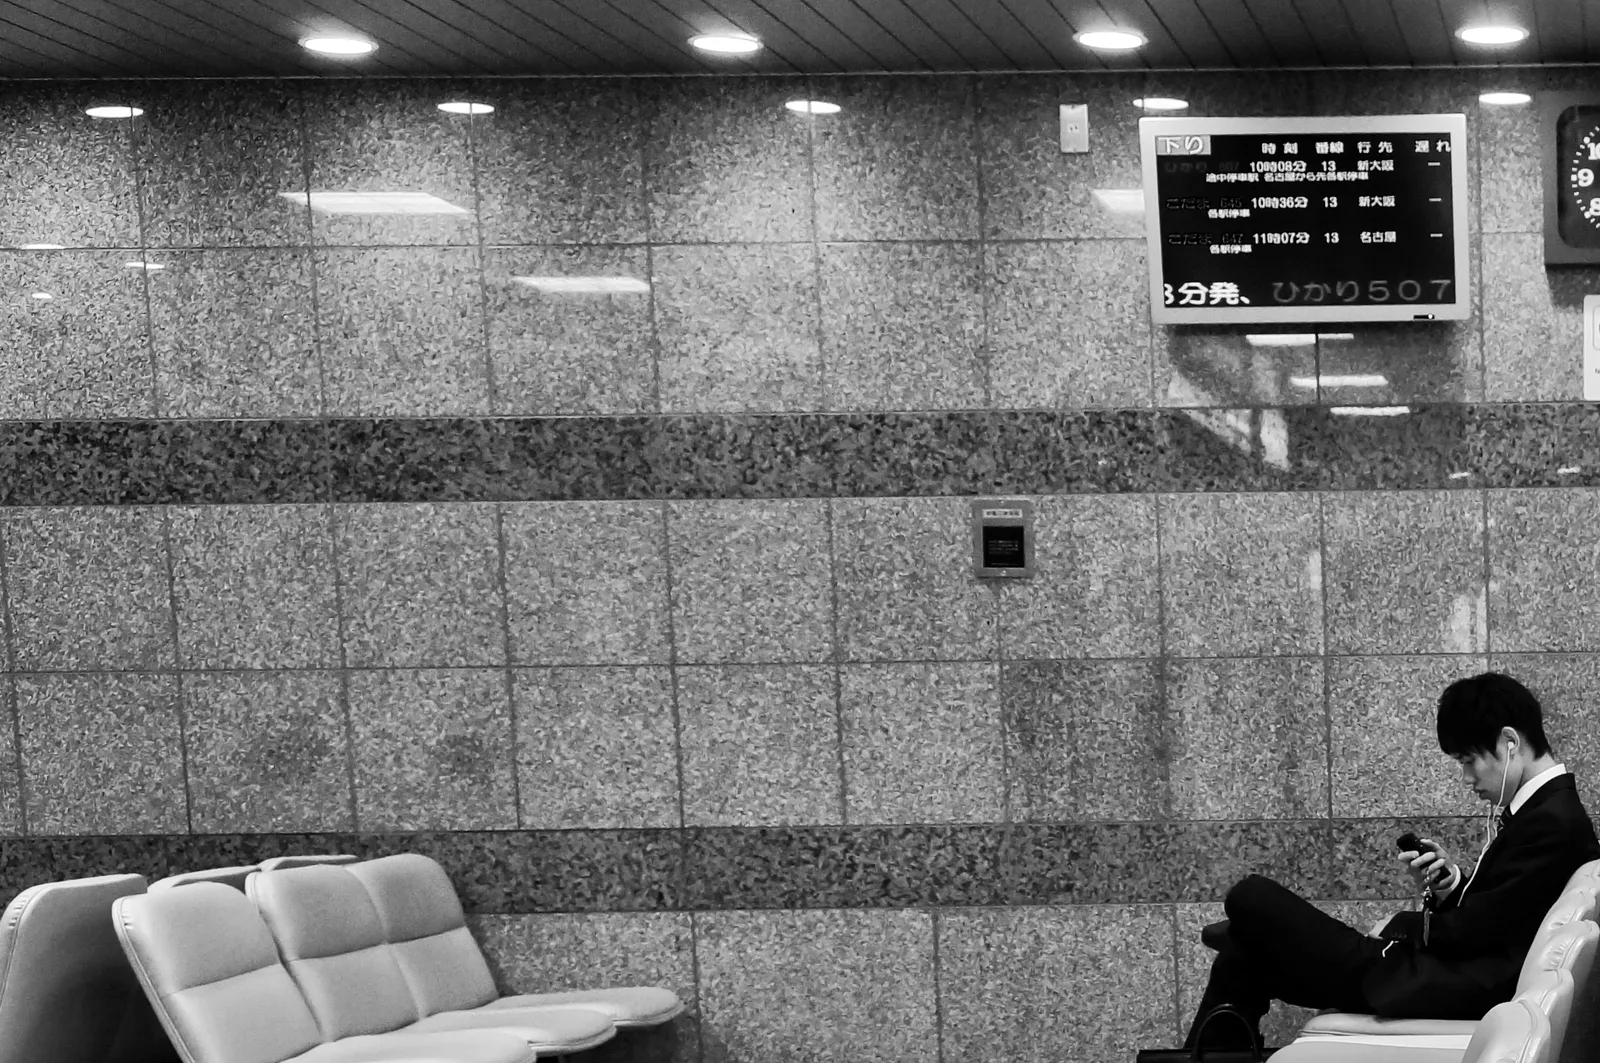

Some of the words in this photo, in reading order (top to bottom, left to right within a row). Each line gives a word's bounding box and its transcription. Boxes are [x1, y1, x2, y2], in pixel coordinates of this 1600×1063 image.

[1157, 137, 1204, 155] 下り
[1315, 141, 1344, 154] 番線
[1321, 160, 1336, 172] 13
[1357, 160, 1394, 172] 新大阪
[1577, 168, 1594, 187] 9
[1322, 196, 1338, 209] 13
[1358, 195, 1395, 207] 新大阪
[1324, 232, 1339, 244] 13
[1360, 231, 1397, 243] 名古屋
